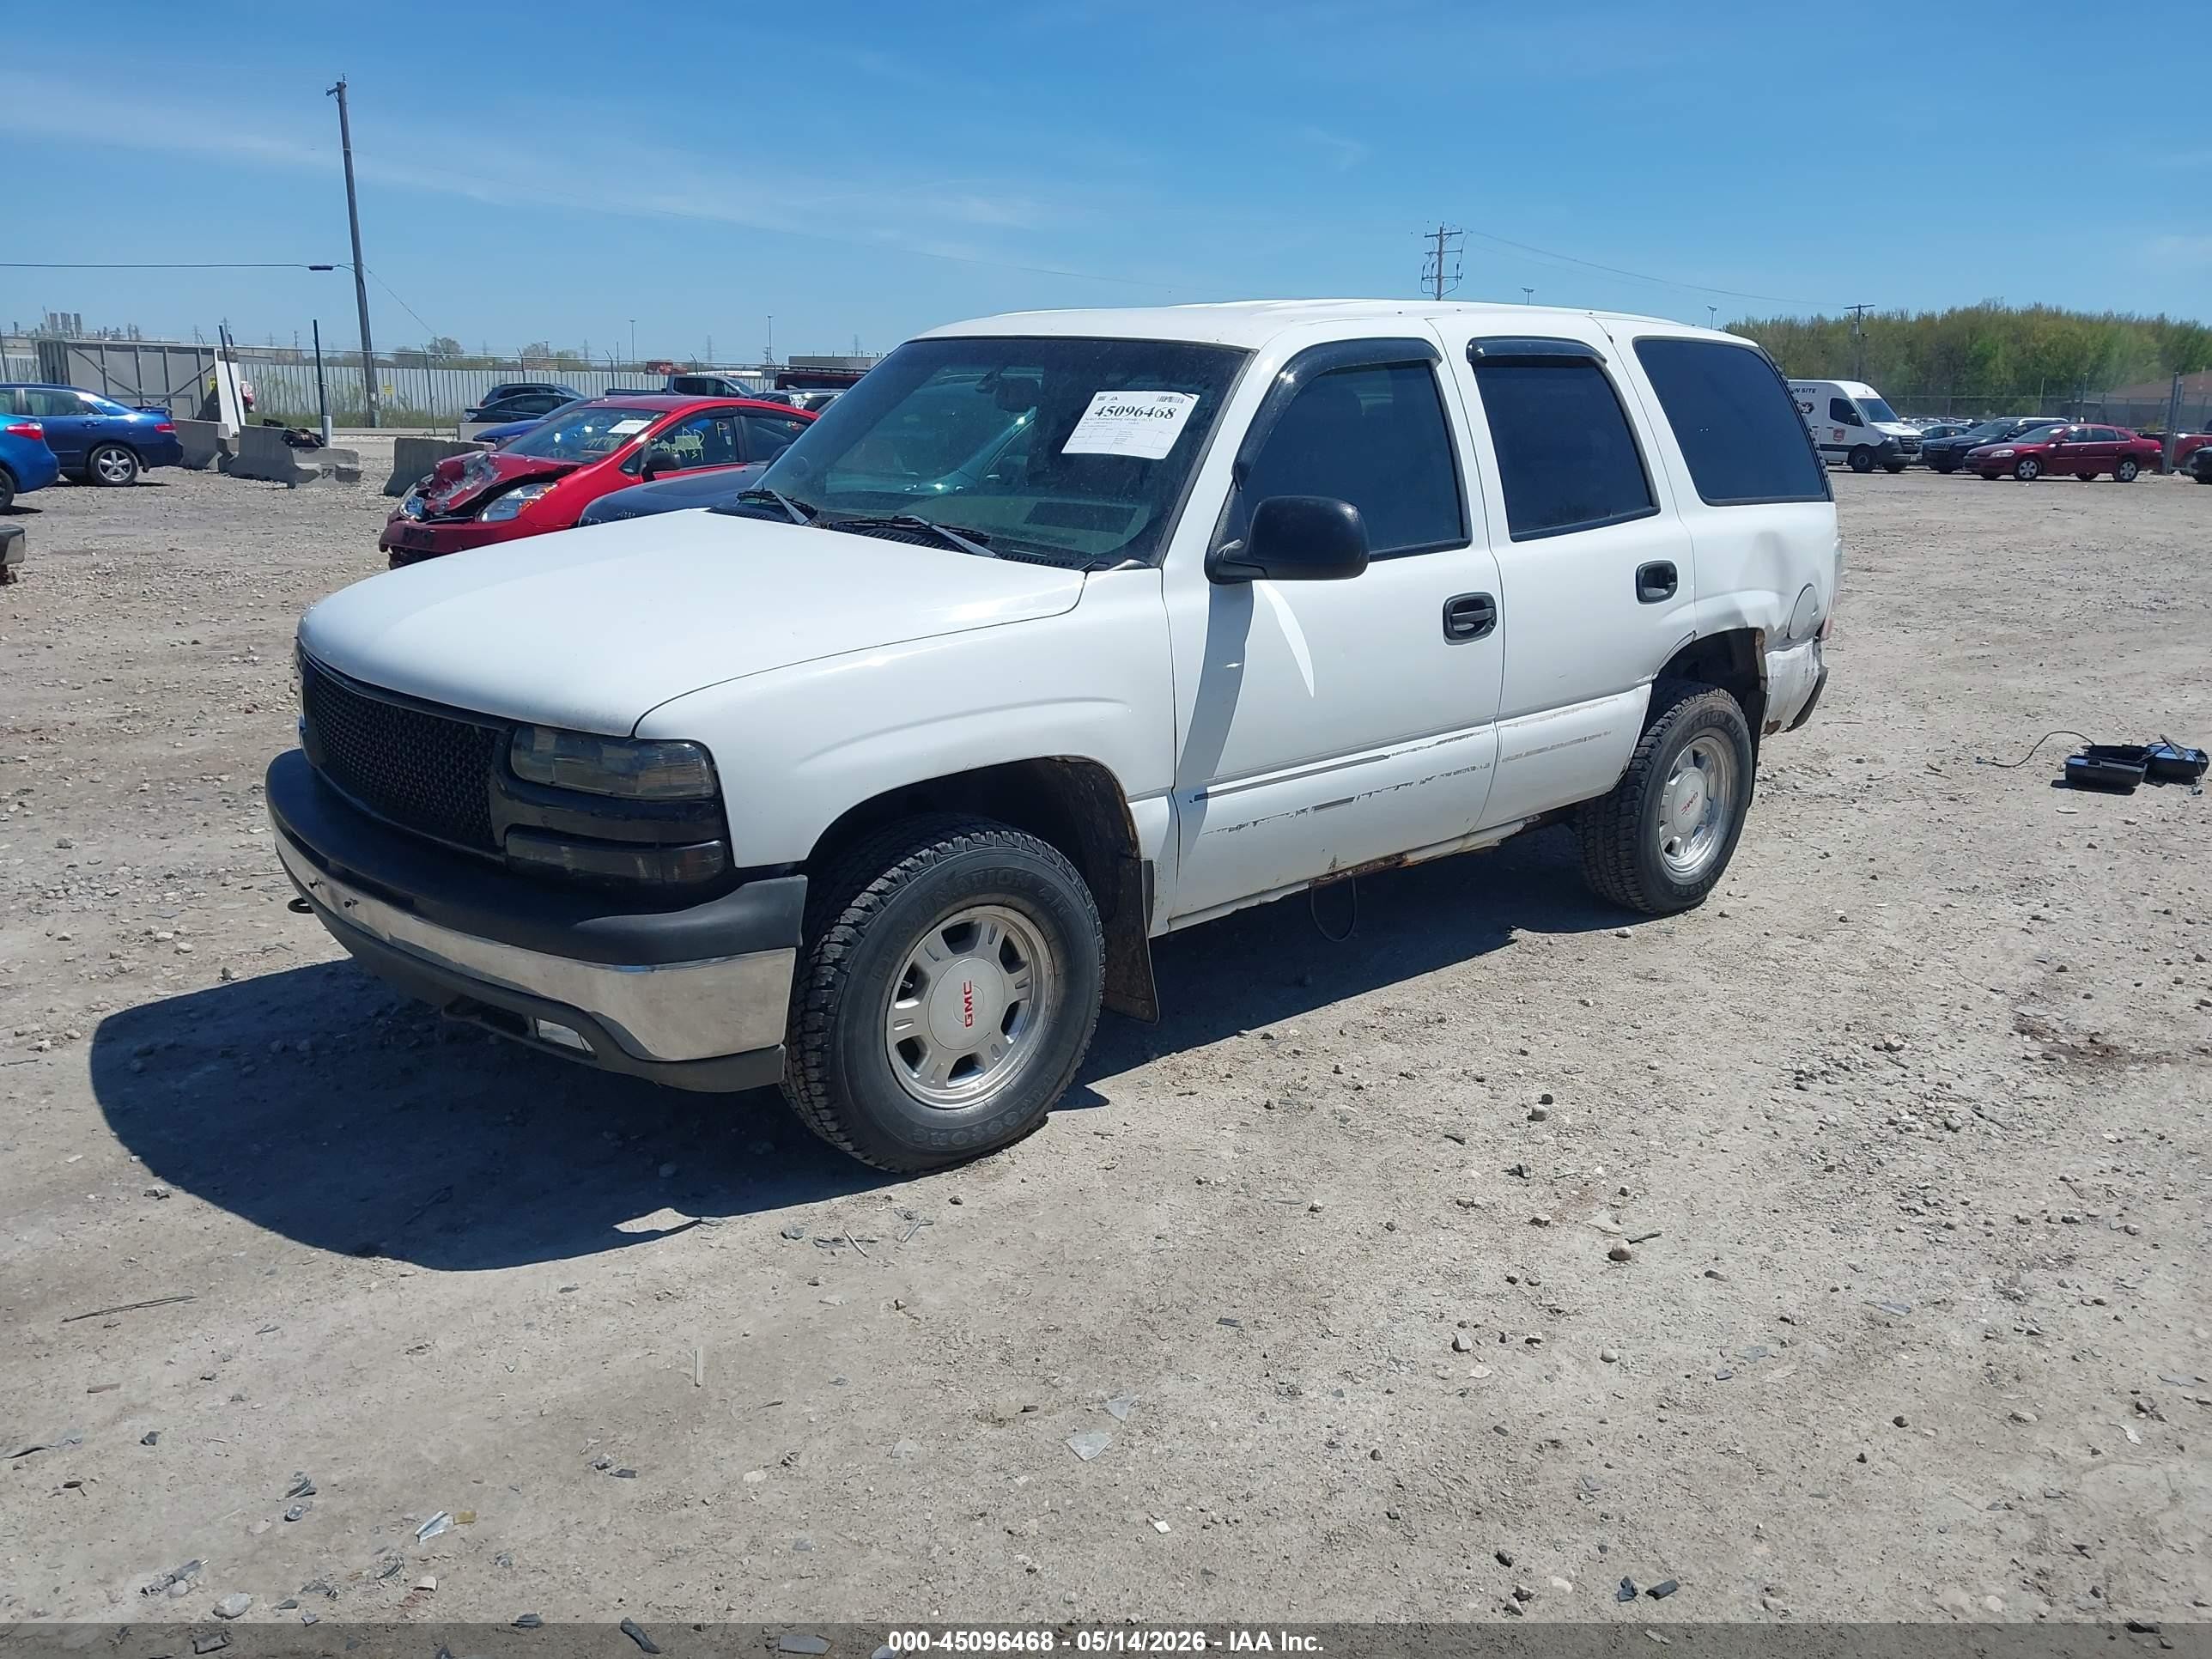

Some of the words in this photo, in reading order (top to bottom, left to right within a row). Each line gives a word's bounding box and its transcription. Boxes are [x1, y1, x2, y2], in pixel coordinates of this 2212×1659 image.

[1094, 405, 1176, 419] 45096468
[1681, 791, 1698, 815] GMC
[963, 980, 974, 1028] GMC
